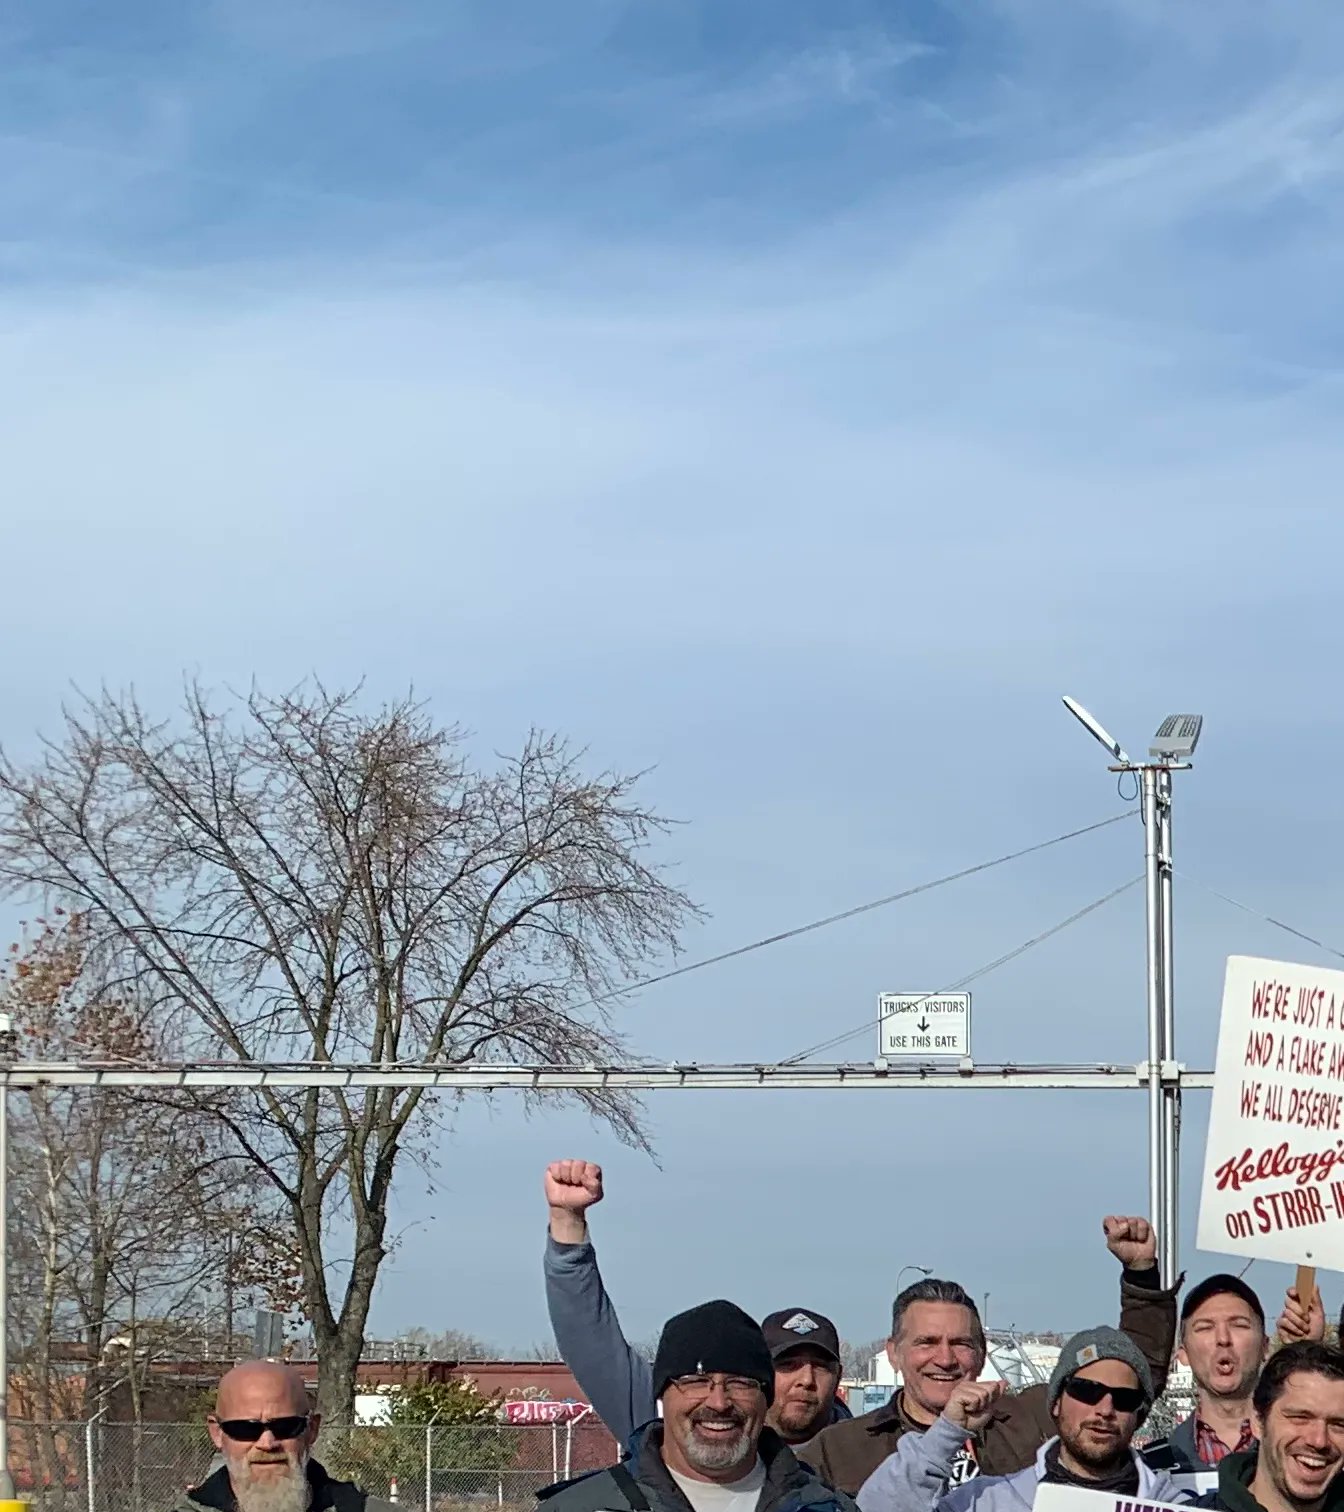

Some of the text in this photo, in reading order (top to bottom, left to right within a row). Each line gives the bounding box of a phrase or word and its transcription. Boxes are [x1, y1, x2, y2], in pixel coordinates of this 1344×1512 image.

[884, 1001, 965, 1013] TRUCKS VISITORS
[1252, 980, 1291, 1023] WE'RE
[1293, 986, 1325, 1028] JUST
[1326, 992, 1335, 1030] A
[889, 1036, 958, 1047] USE THIS GATE
[1244, 1029, 1274, 1068] AND
[1276, 1034, 1285, 1072] A
[1289, 1036, 1327, 1076] FLAKE
[1240, 1080, 1262, 1119] WE
[1263, 1084, 1283, 1122] ALL
[1287, 1087, 1343, 1131] DESERVE
[1225, 1210, 1255, 1239] on
